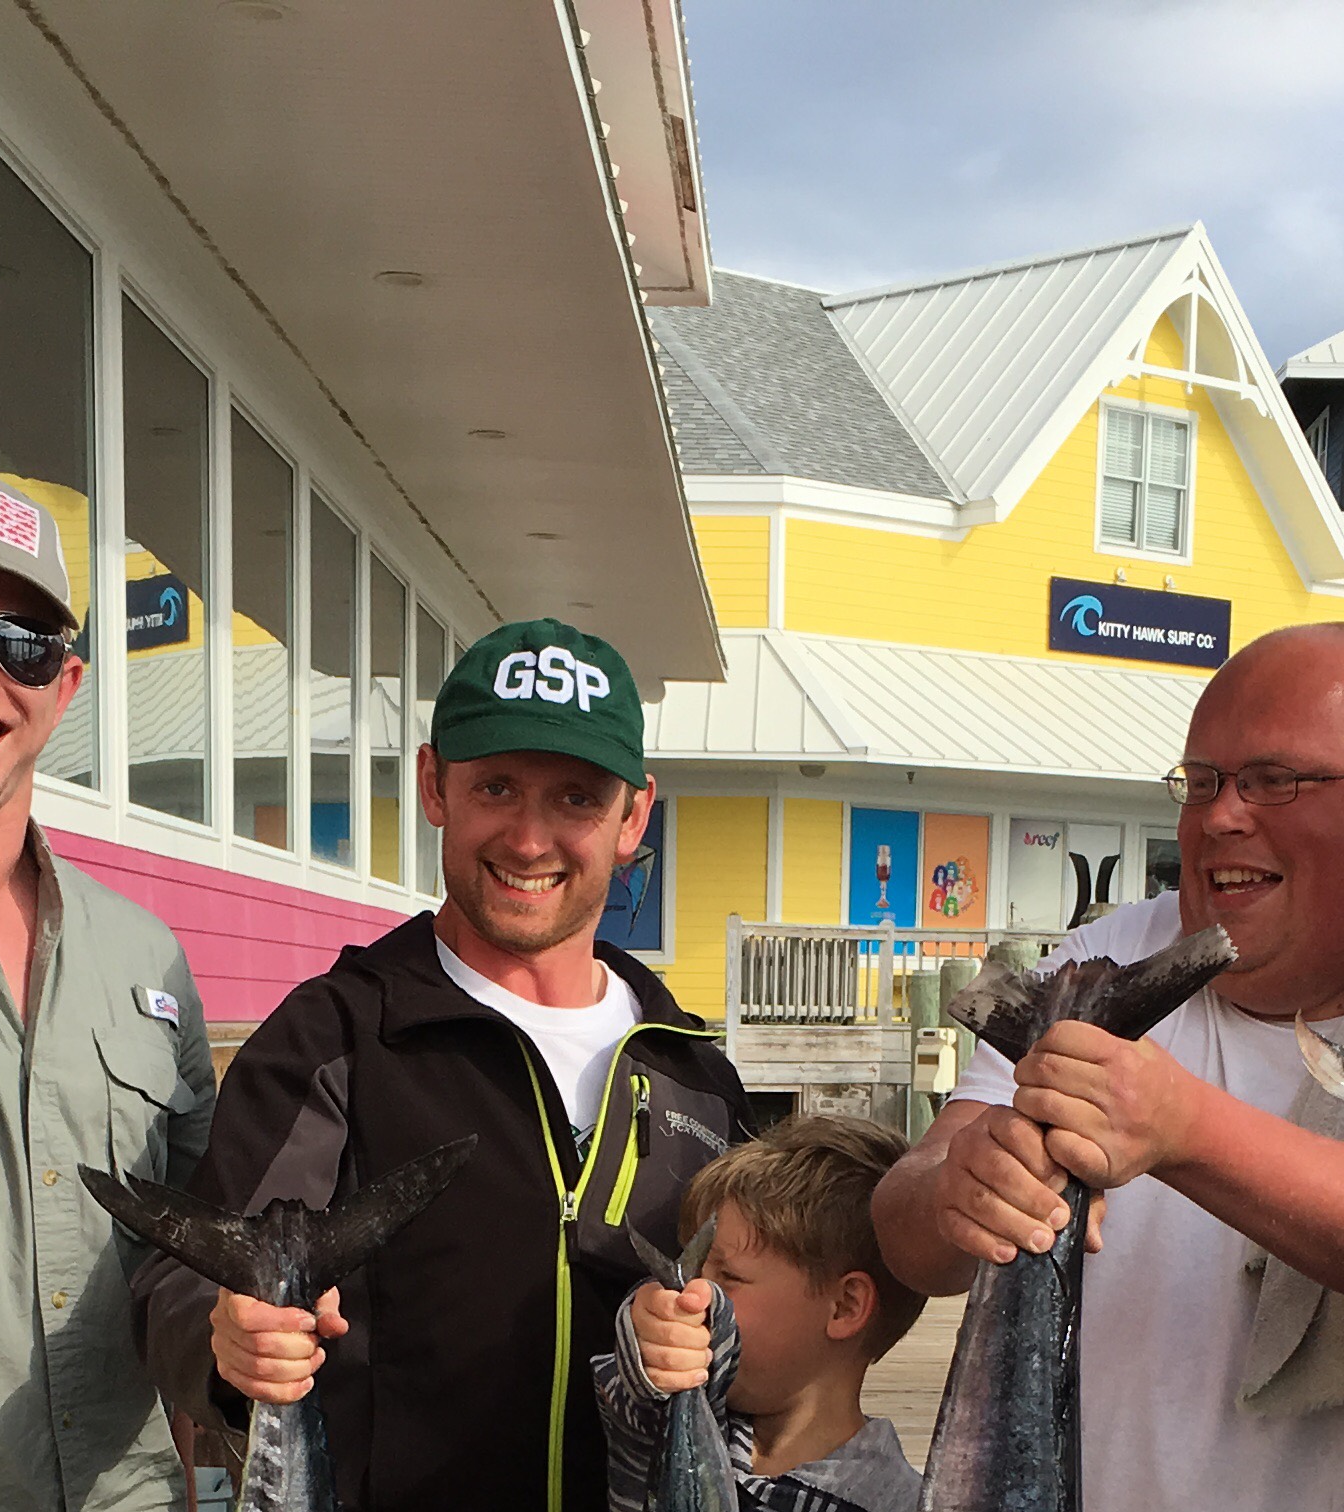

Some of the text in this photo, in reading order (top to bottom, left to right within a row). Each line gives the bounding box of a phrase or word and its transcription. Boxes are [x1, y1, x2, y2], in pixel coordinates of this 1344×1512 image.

[1098, 621, 1214, 649] KITTY HAWK SURF CO.
[494, 646, 611, 713] GSP
[1030, 832, 1060, 850] reef
[665, 1110, 689, 1124] FREE
